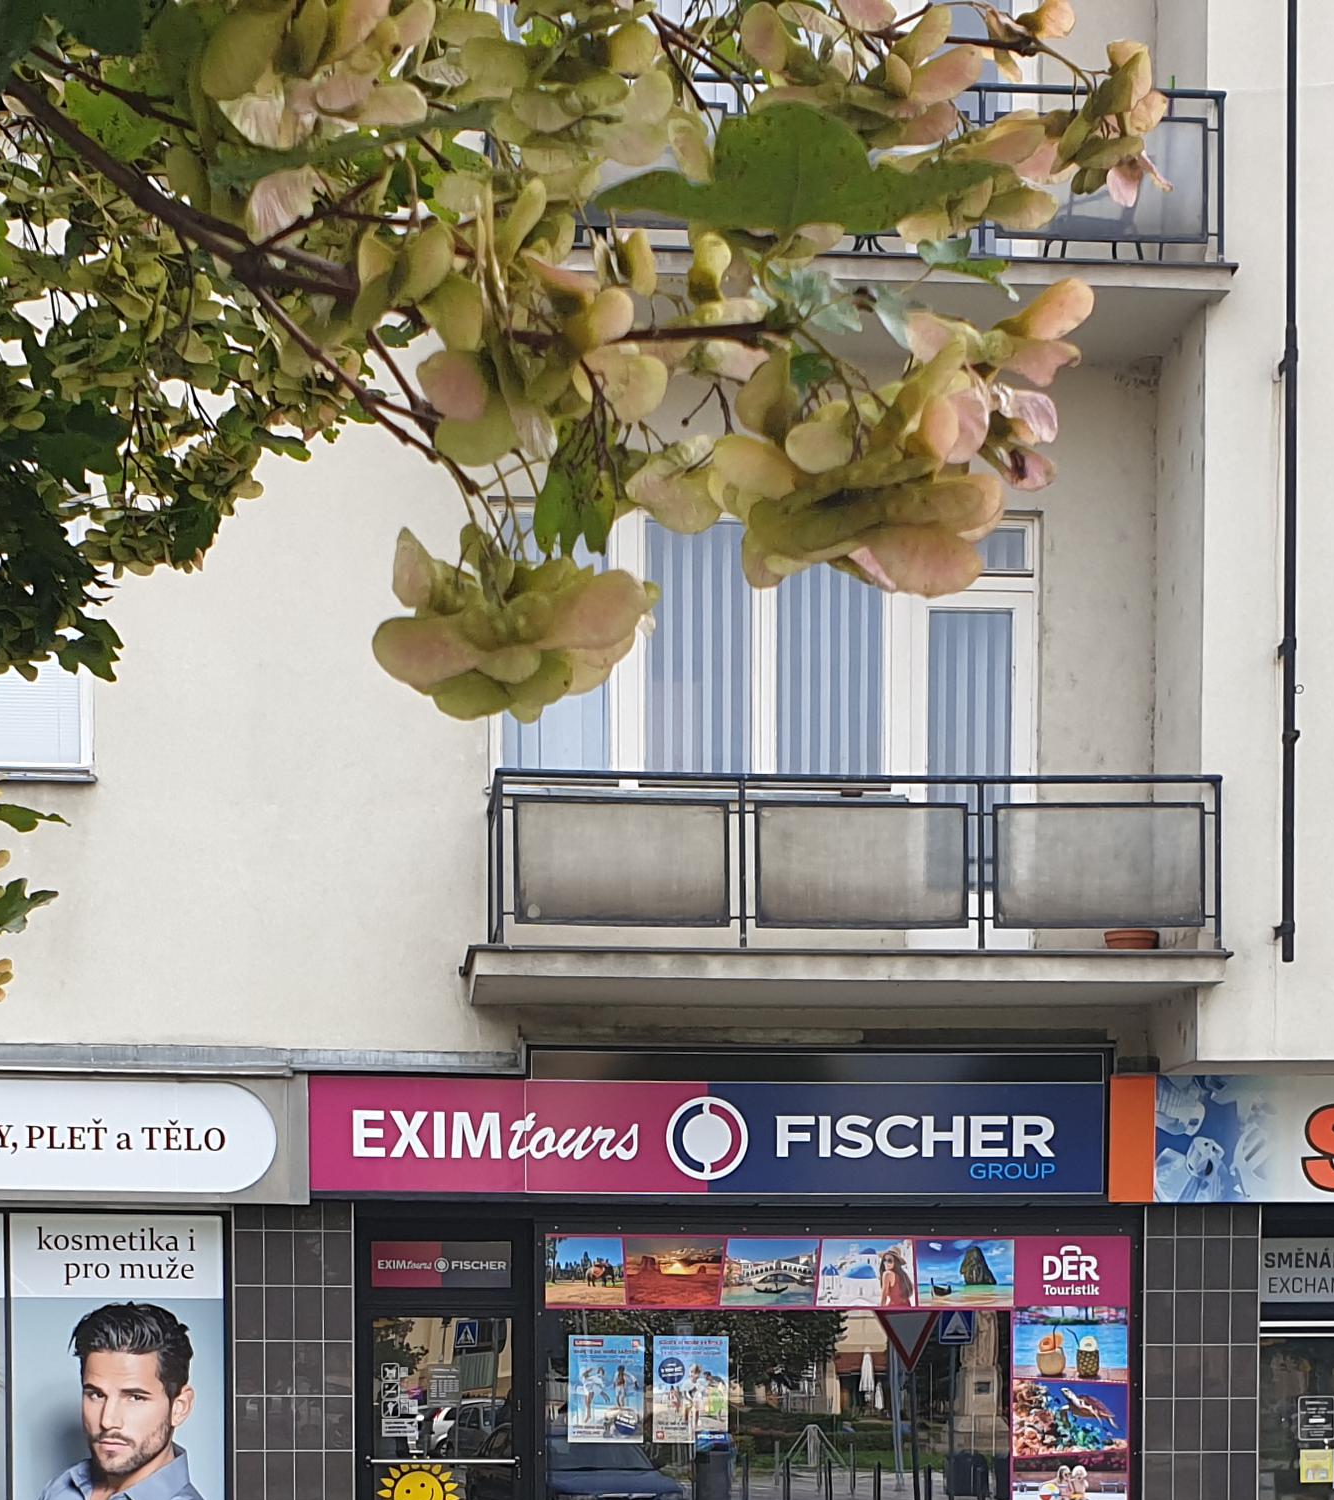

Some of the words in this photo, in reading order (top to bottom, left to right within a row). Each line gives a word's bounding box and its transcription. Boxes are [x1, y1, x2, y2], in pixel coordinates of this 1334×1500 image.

[24, 1118, 107, 1151] PLEŤ
[116, 1131, 132, 1151] a
[141, 1120, 227, 1152] TĚLO
[351, 1110, 640, 1162] EXIMtours
[775, 1115, 1055, 1158] FISCHER
[969, 1162, 1056, 1180] GROUP
[36, 1227, 179, 1252] kosmetika
[187, 1228, 196, 1252] i
[64, 1263, 110, 1286] pro
[119, 1257, 195, 1280] muže
[451, 1261, 506, 1270] FISCHER
[1043, 1284, 1099, 1295] Touristik
